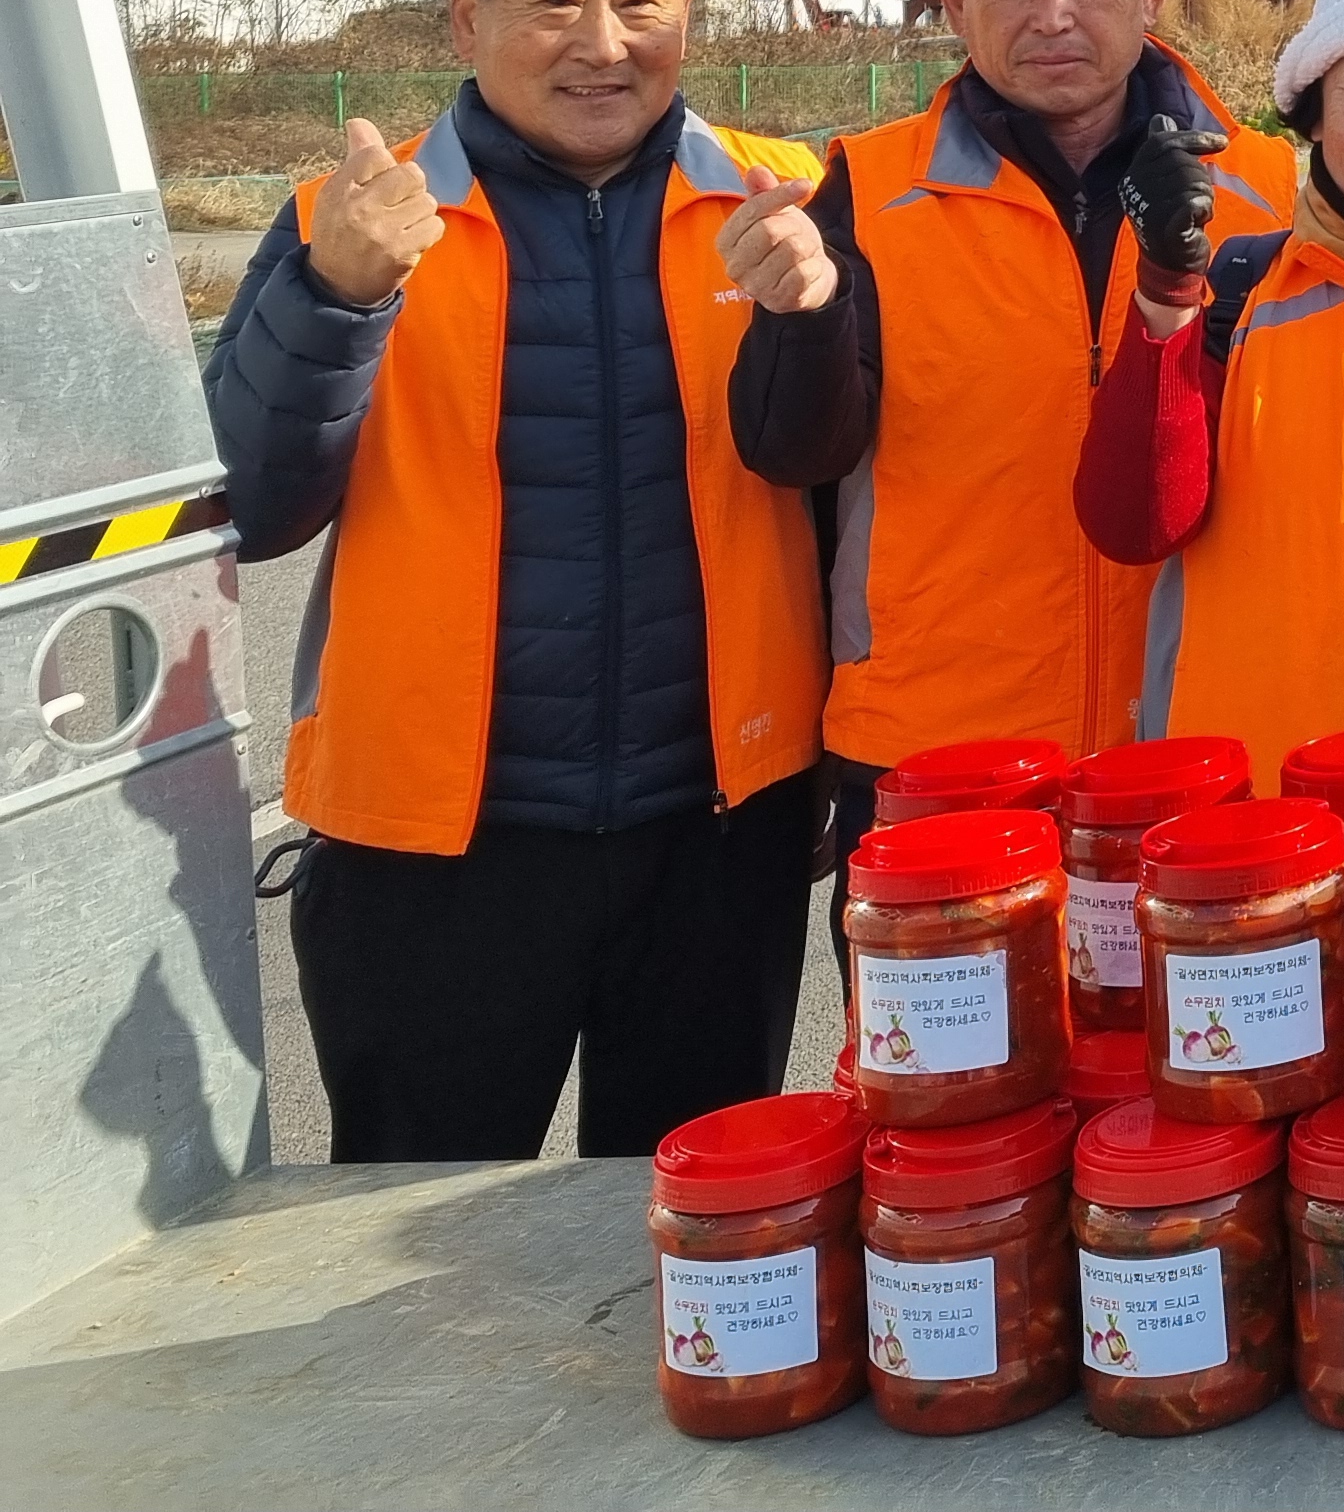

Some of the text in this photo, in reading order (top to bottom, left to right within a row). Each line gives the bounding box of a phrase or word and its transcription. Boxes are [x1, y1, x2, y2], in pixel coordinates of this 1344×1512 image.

[1101, 941, 1137, 950] 건강하세
[872, 995, 986, 1012] 순무김치 맛있게 드시고
[1185, 984, 1304, 1008] 순무김치 맛있게 드시고
[923, 1013, 980, 1029] 건강하세요
[1244, 1004, 1299, 1023] 건강하세요
[675, 1295, 792, 1315] 순무김치 맛있게 드시고
[1090, 1294, 1200, 1313] 순무김치 맛있게 드시고
[727, 1314, 787, 1332] 건강하세요
[902, 1309, 932, 1322] 맛있게
[938, 1308, 973, 1320] 드시고
[1137, 1313, 1196, 1330] 건강하세요
[913, 1326, 968, 1340] 건강하세요
